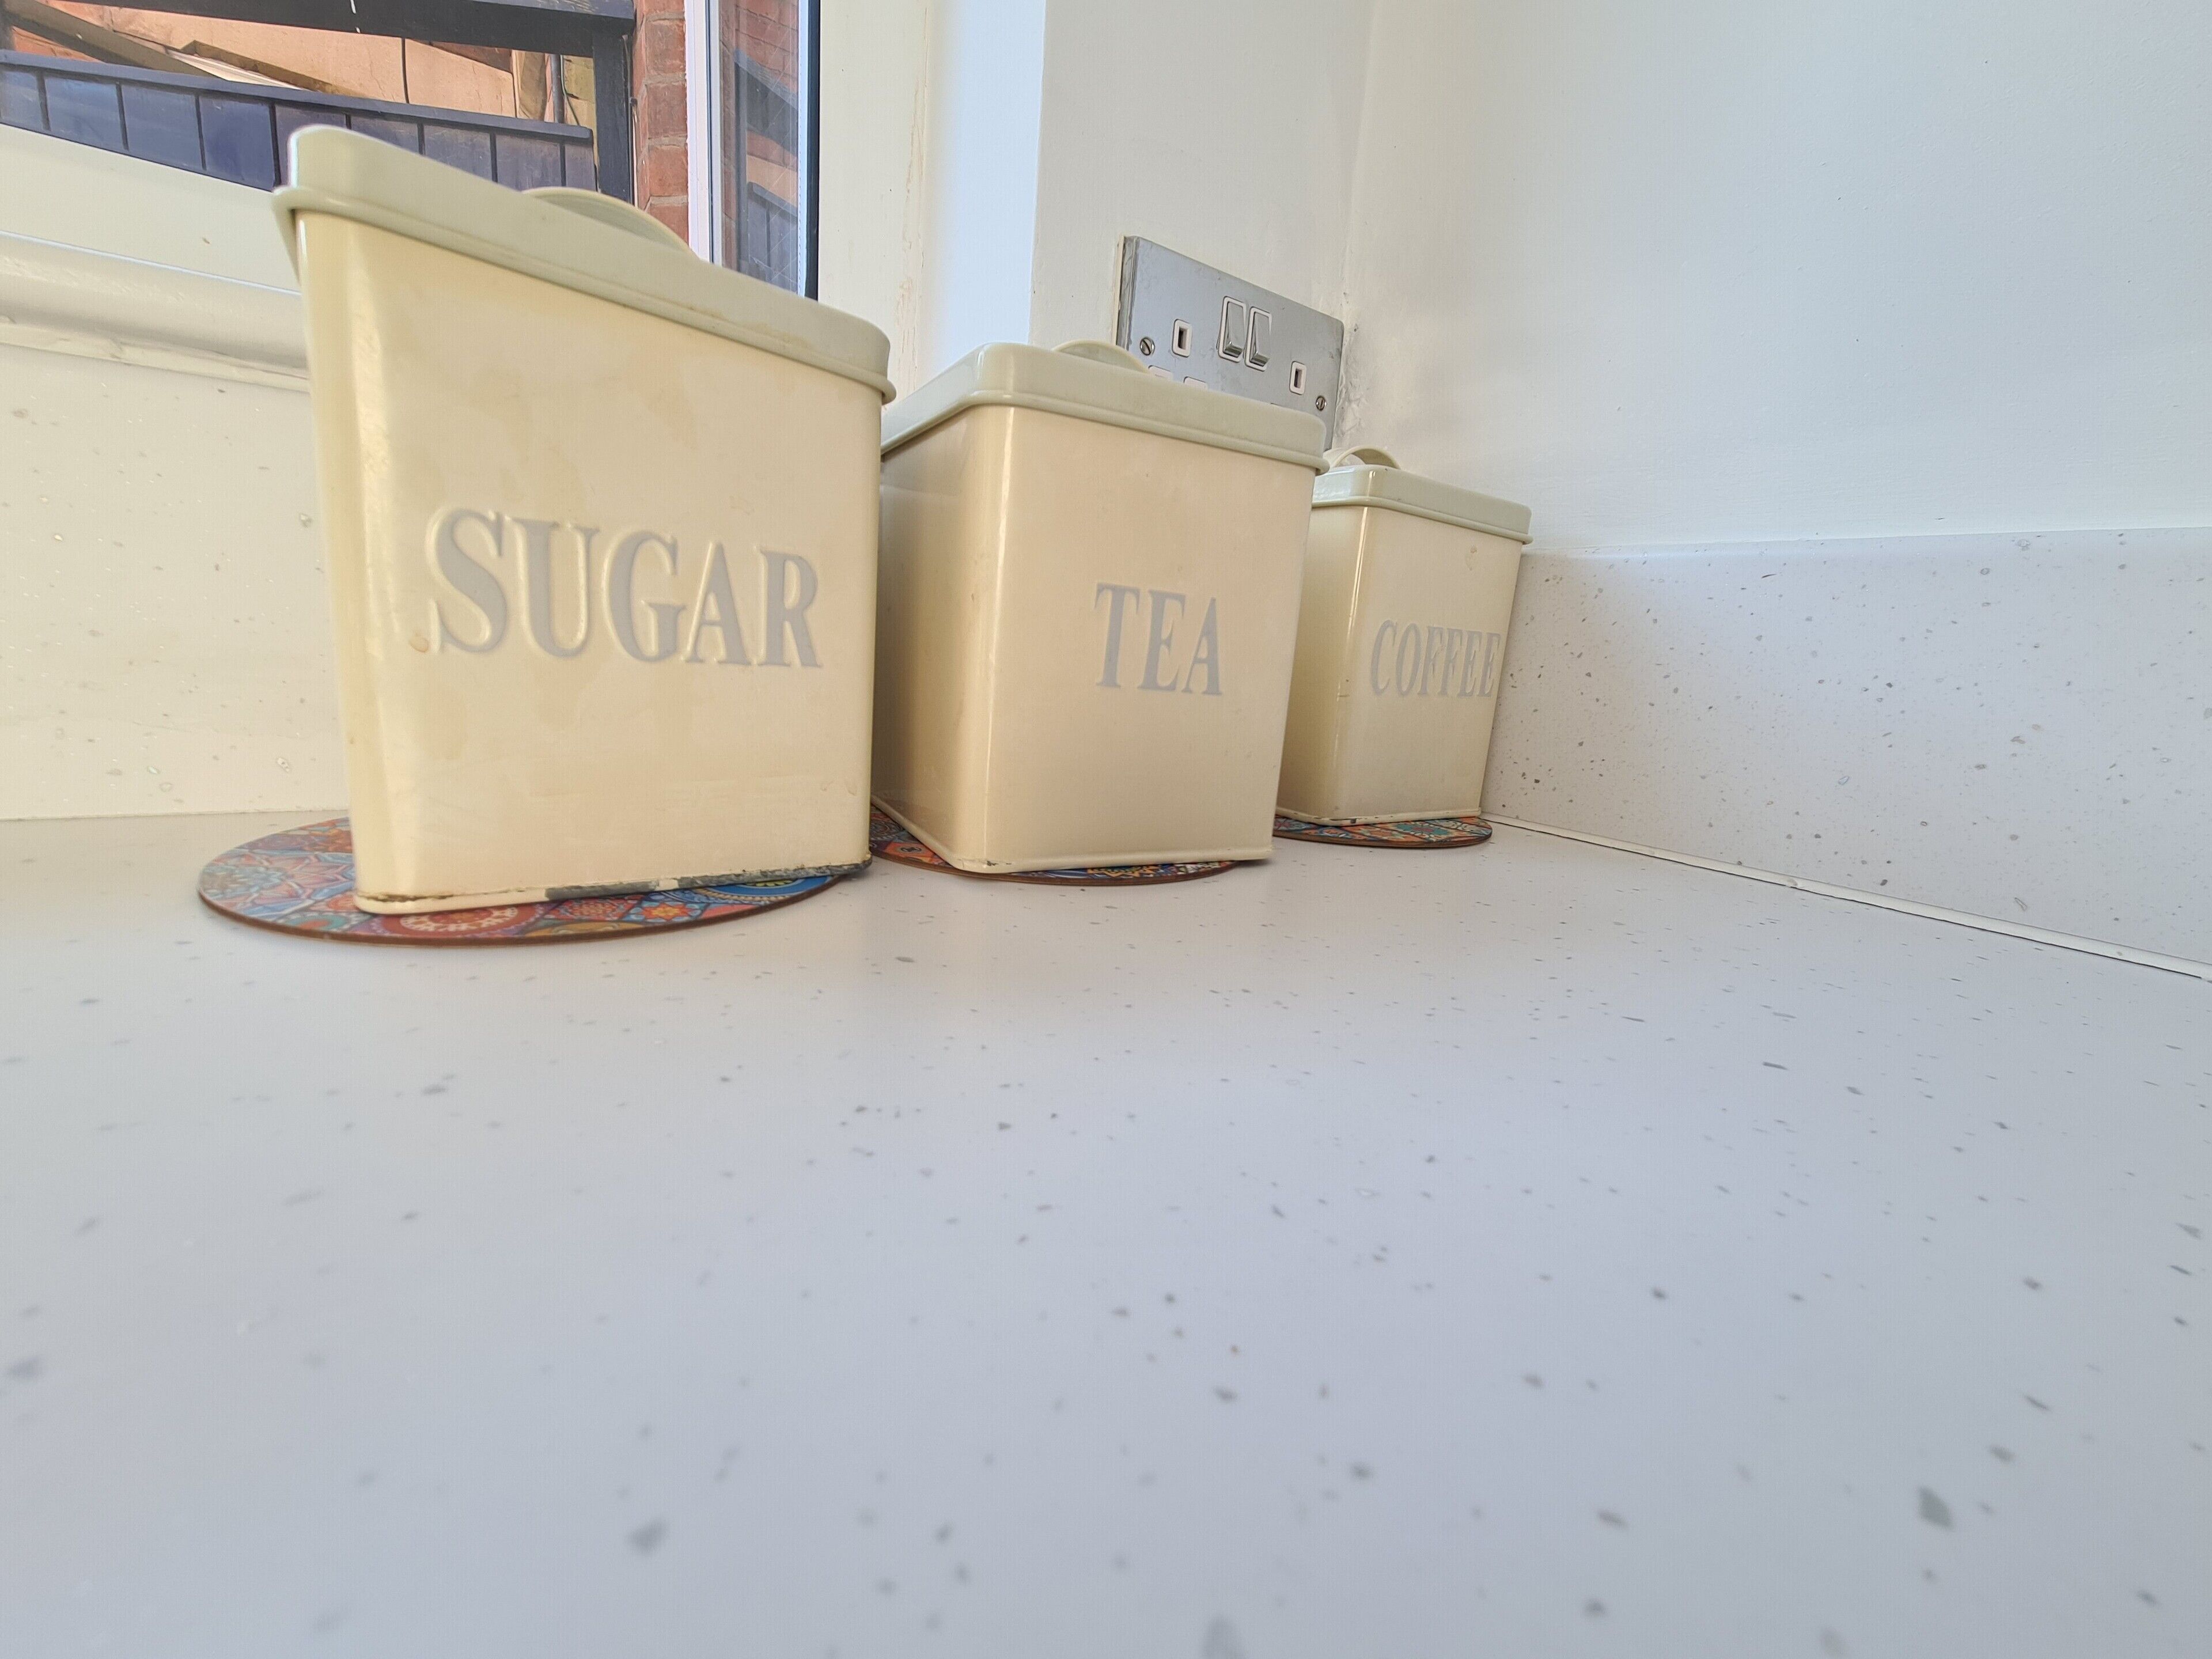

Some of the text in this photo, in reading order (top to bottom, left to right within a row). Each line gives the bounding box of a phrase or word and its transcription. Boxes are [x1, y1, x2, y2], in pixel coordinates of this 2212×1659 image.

[426, 507, 822, 668] SUGAR
[1094, 582, 1223, 696] TEA
[1370, 620, 1501, 697] COFFEE
